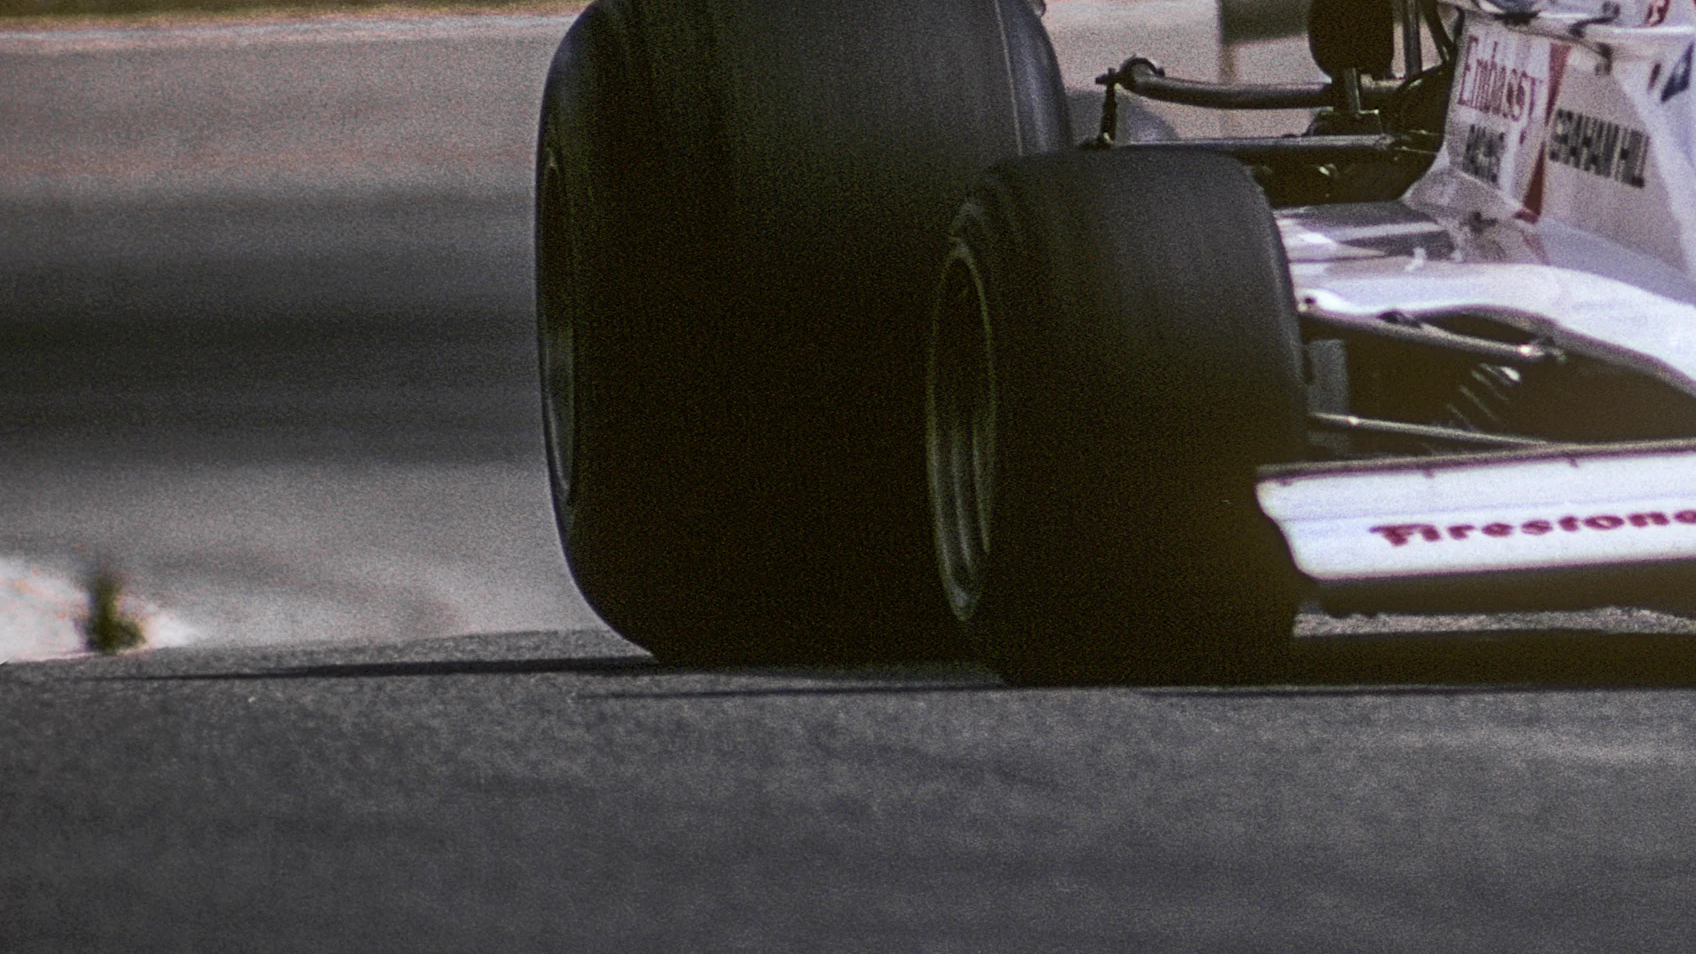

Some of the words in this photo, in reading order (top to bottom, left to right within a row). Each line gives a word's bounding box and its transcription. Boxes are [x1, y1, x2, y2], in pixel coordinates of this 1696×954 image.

[1457, 35, 1543, 145] Embassy
[1549, 108, 1620, 179] GRAHAM
[1613, 127, 1650, 189] HILL
